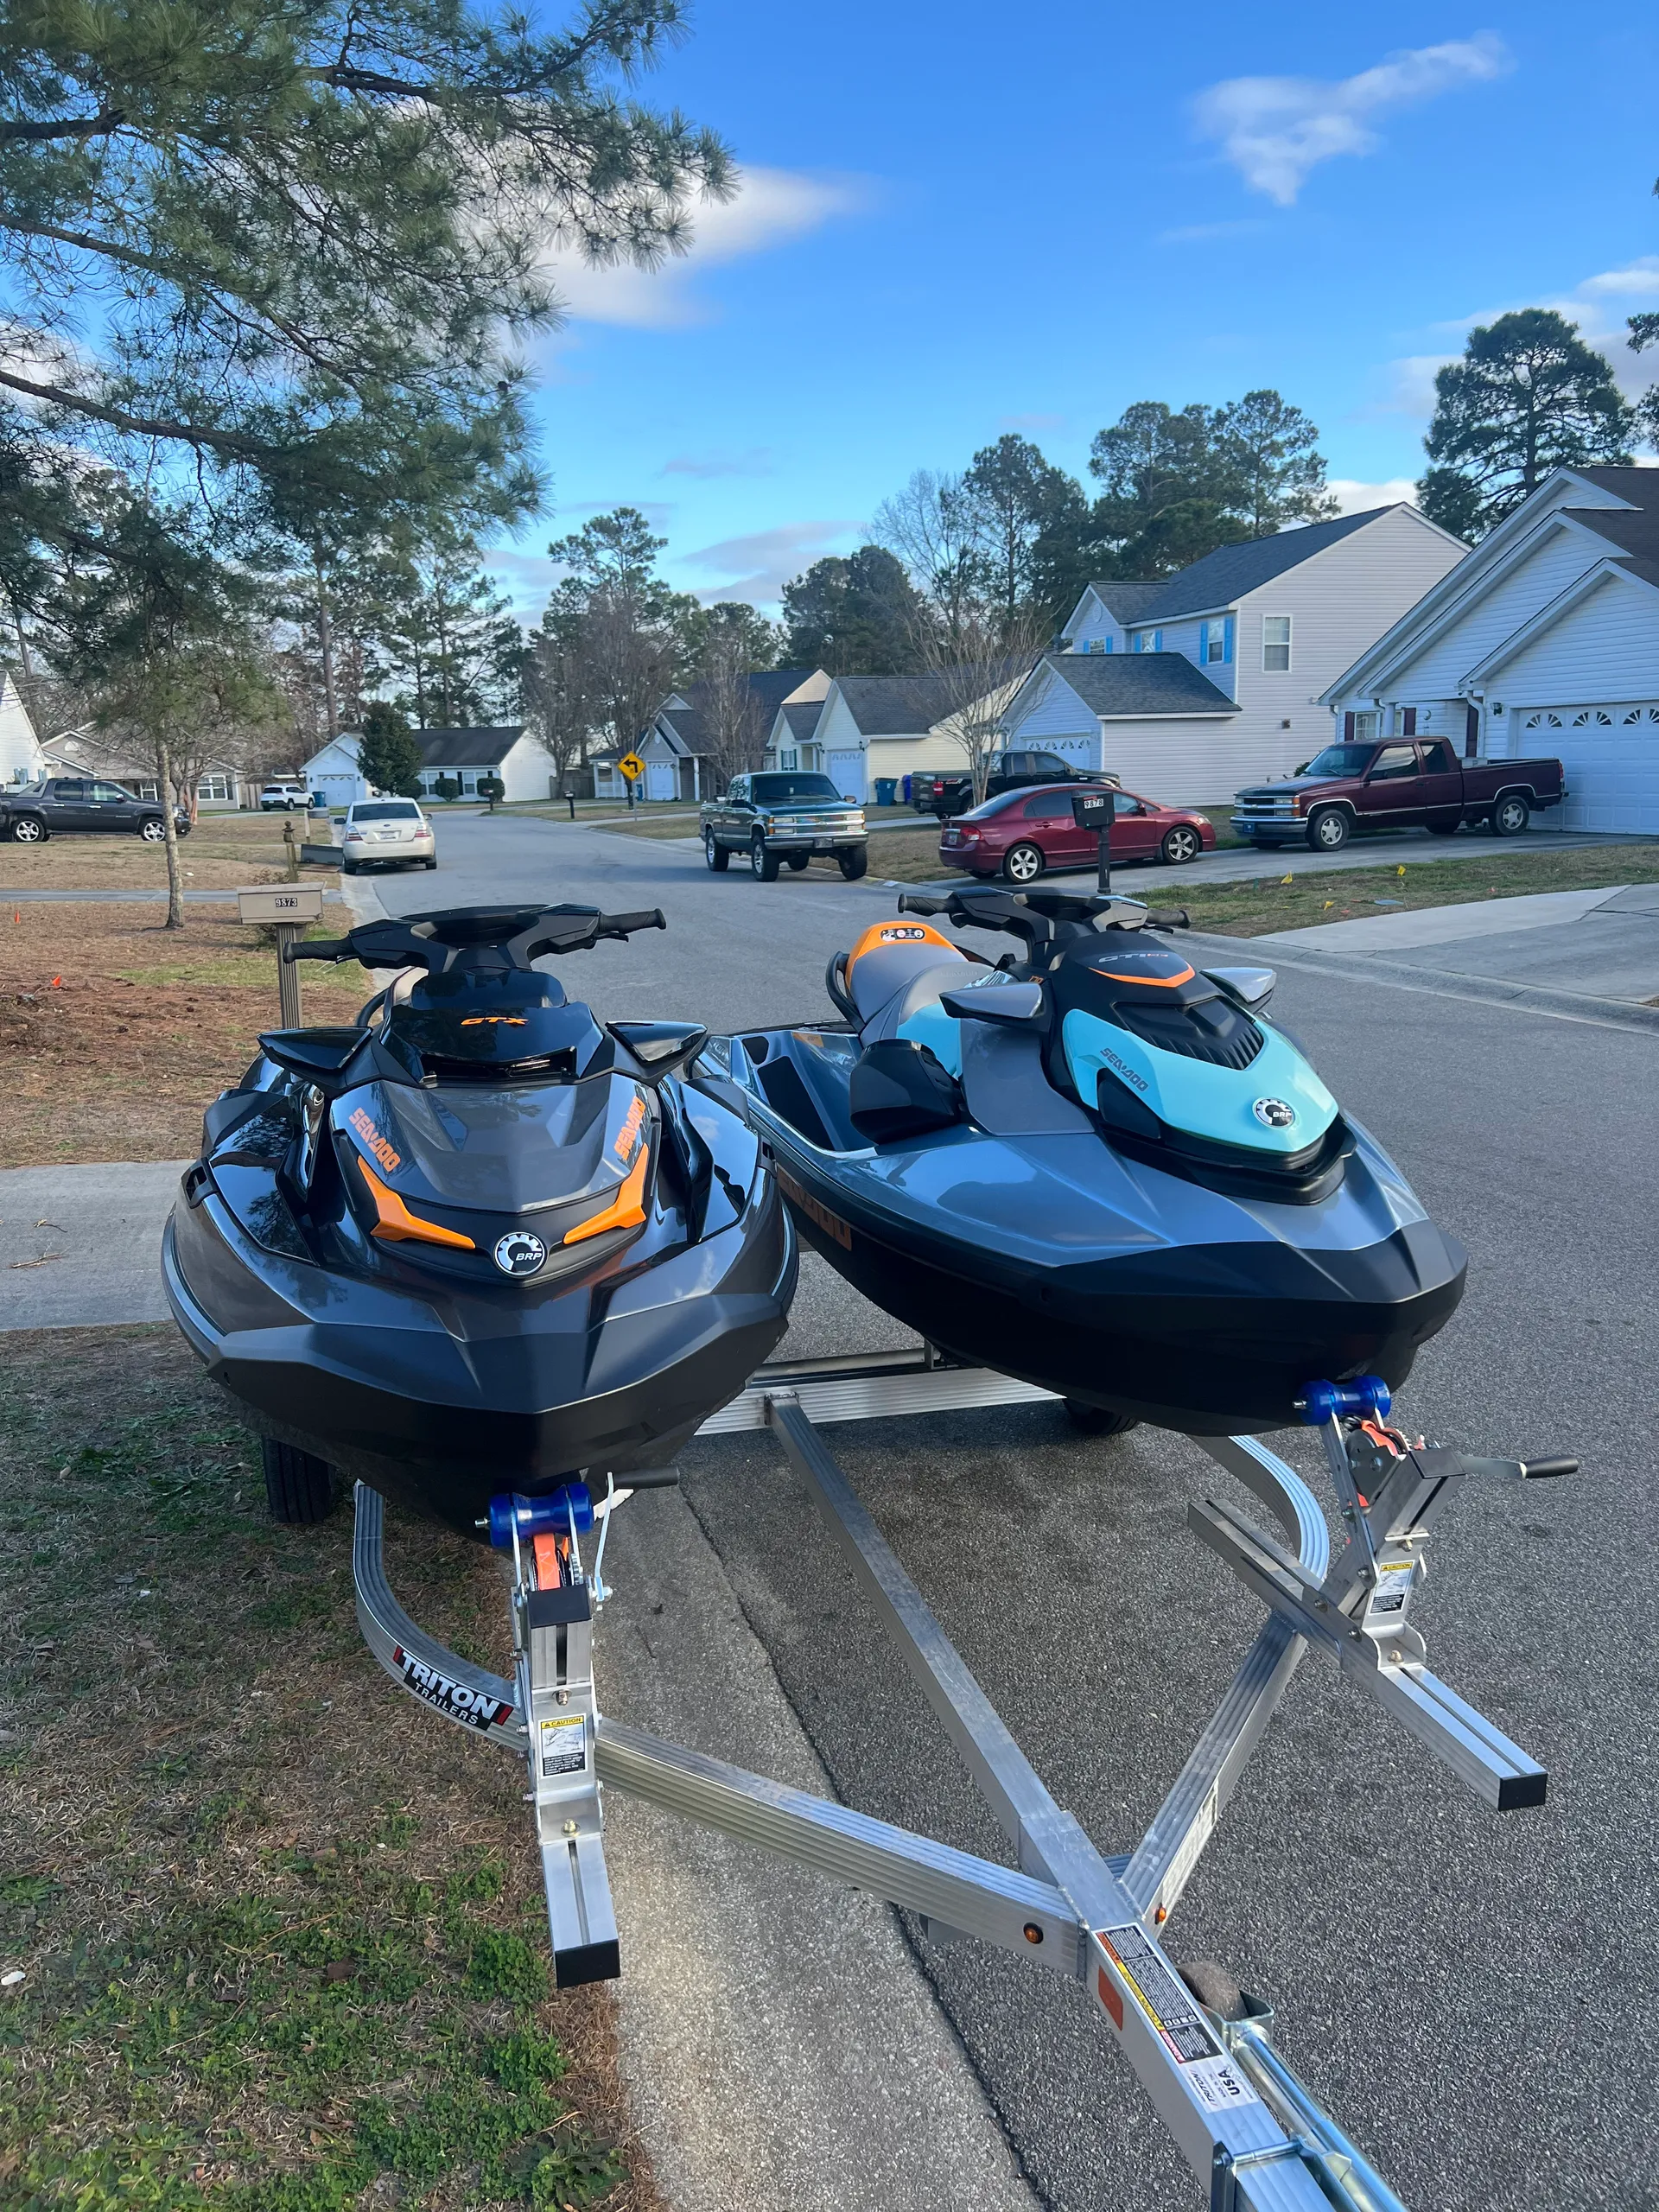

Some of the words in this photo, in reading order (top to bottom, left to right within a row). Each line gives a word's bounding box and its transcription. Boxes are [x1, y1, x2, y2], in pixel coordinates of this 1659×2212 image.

[1084, 798, 1103, 808] 9878
[276, 898, 297, 907] 9873
[461, 1016, 529, 1026] GTX
[515, 1252, 543, 1262] BRP
[402, 1650, 500, 1720] TRITON
[415, 1681, 479, 1725] TRAILERS
[551, 1717, 582, 1726] CAUTION
[1191, 2072, 1216, 2102] TRITON
[1218, 2069, 1241, 2095] USA
